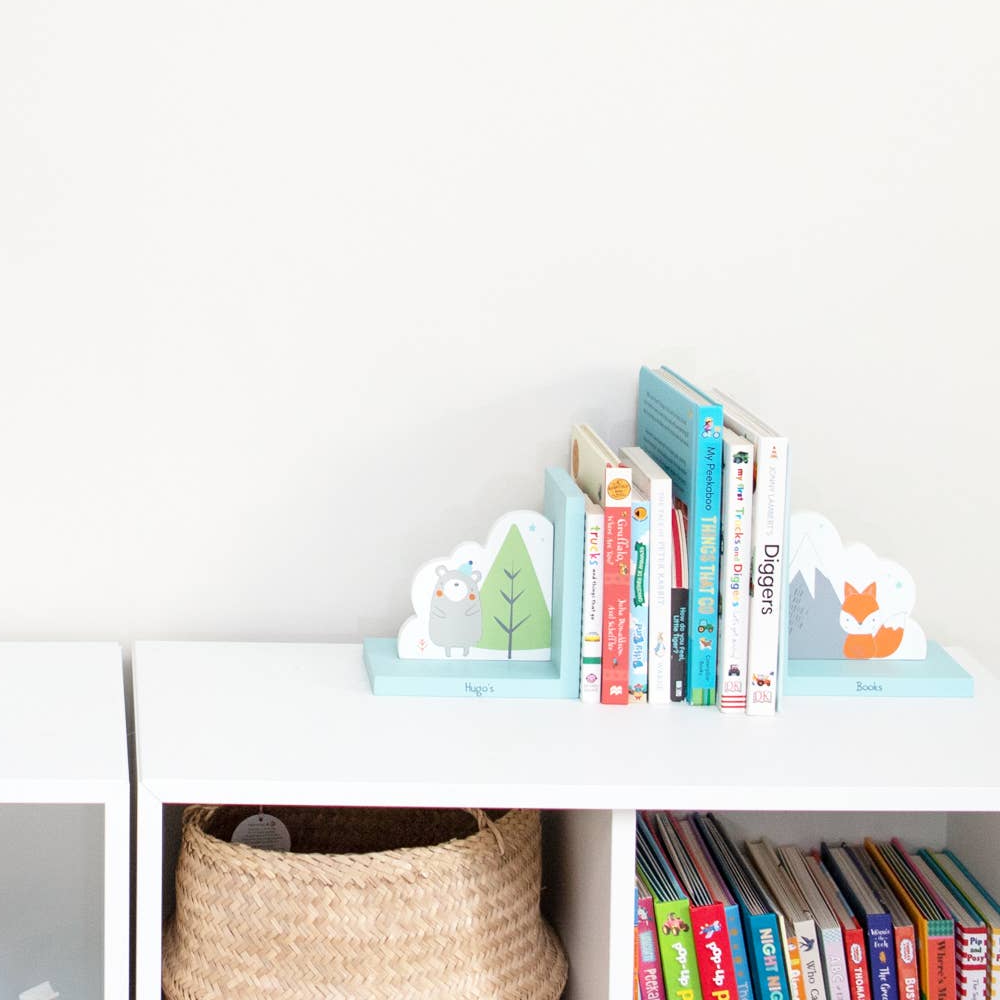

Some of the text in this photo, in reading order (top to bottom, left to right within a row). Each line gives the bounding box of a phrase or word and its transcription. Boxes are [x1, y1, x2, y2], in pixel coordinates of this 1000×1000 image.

[737, 468, 744, 481] my
[736, 483, 745, 501] first
[617, 518, 629, 562] Gruffalo,
[697, 446, 717, 615] My Peekaboo THINGS THAT GO
[733, 507, 745, 544] Trucks
[589, 525, 600, 566] trucks
[733, 546, 741, 562] and
[730, 564, 743, 607] Diggers
[757, 544, 780, 615] Diggers
[607, 605, 617, 651] Axel Scheffler
[616, 599, 626, 656] Julie Donaldson
[671, 633, 680, 654] Tiger?
[679, 623, 686, 632] do
[465, 681, 495, 696] Hugo's
[856, 681, 883, 691] Books
[759, 927, 779, 972] NIGHT
[970, 937, 983, 946] Pip
[672, 942, 690, 987] pop-up
[705, 942, 725, 986] pop-up
[806, 960, 817, 984] Who
[878, 966, 890, 981] The
[937, 940, 947, 984] Where's
[967, 954, 984, 963] Posy
[854, 967, 866, 1000] THOMA
[904, 977, 916, 1000] BUS
